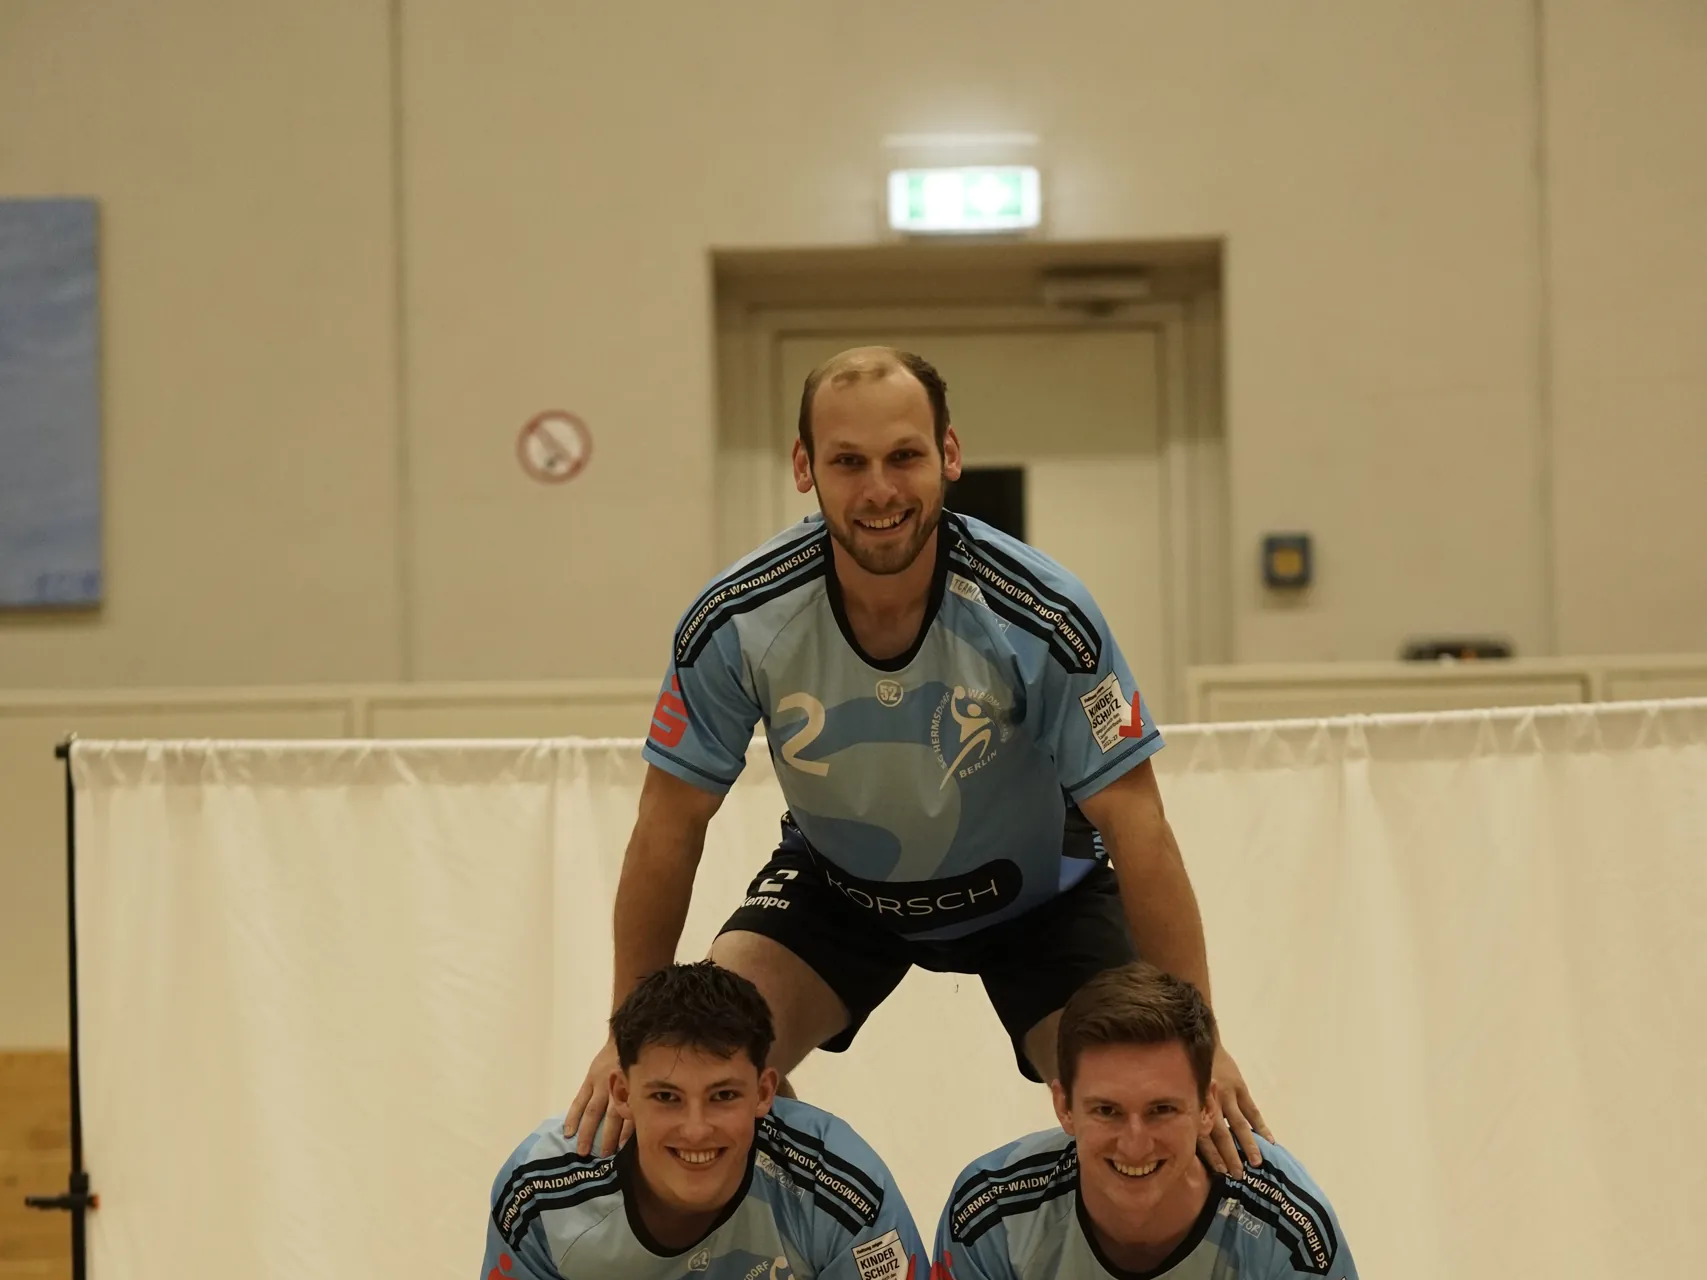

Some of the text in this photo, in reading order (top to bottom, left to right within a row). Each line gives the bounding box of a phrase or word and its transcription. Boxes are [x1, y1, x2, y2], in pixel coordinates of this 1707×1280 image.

[955, 540, 1084, 652] HERMSDORF-WAIDMANNSLT
[1081, 652, 1096, 668] SG
[880, 685, 898, 701] 52
[1088, 691, 1114, 718] KINDER
[931, 692, 950, 752] HERMSDORF
[1092, 698, 1121, 729] SCHUTZ
[777, 692, 830, 776] 2
[960, 750, 997, 778] BERLIN
[826, 868, 999, 917] KORSCH
[860, 1247, 895, 1270] KINDER
[864, 1258, 900, 1280] SCHUTZ
[1316, 1252, 1328, 1269] SG
